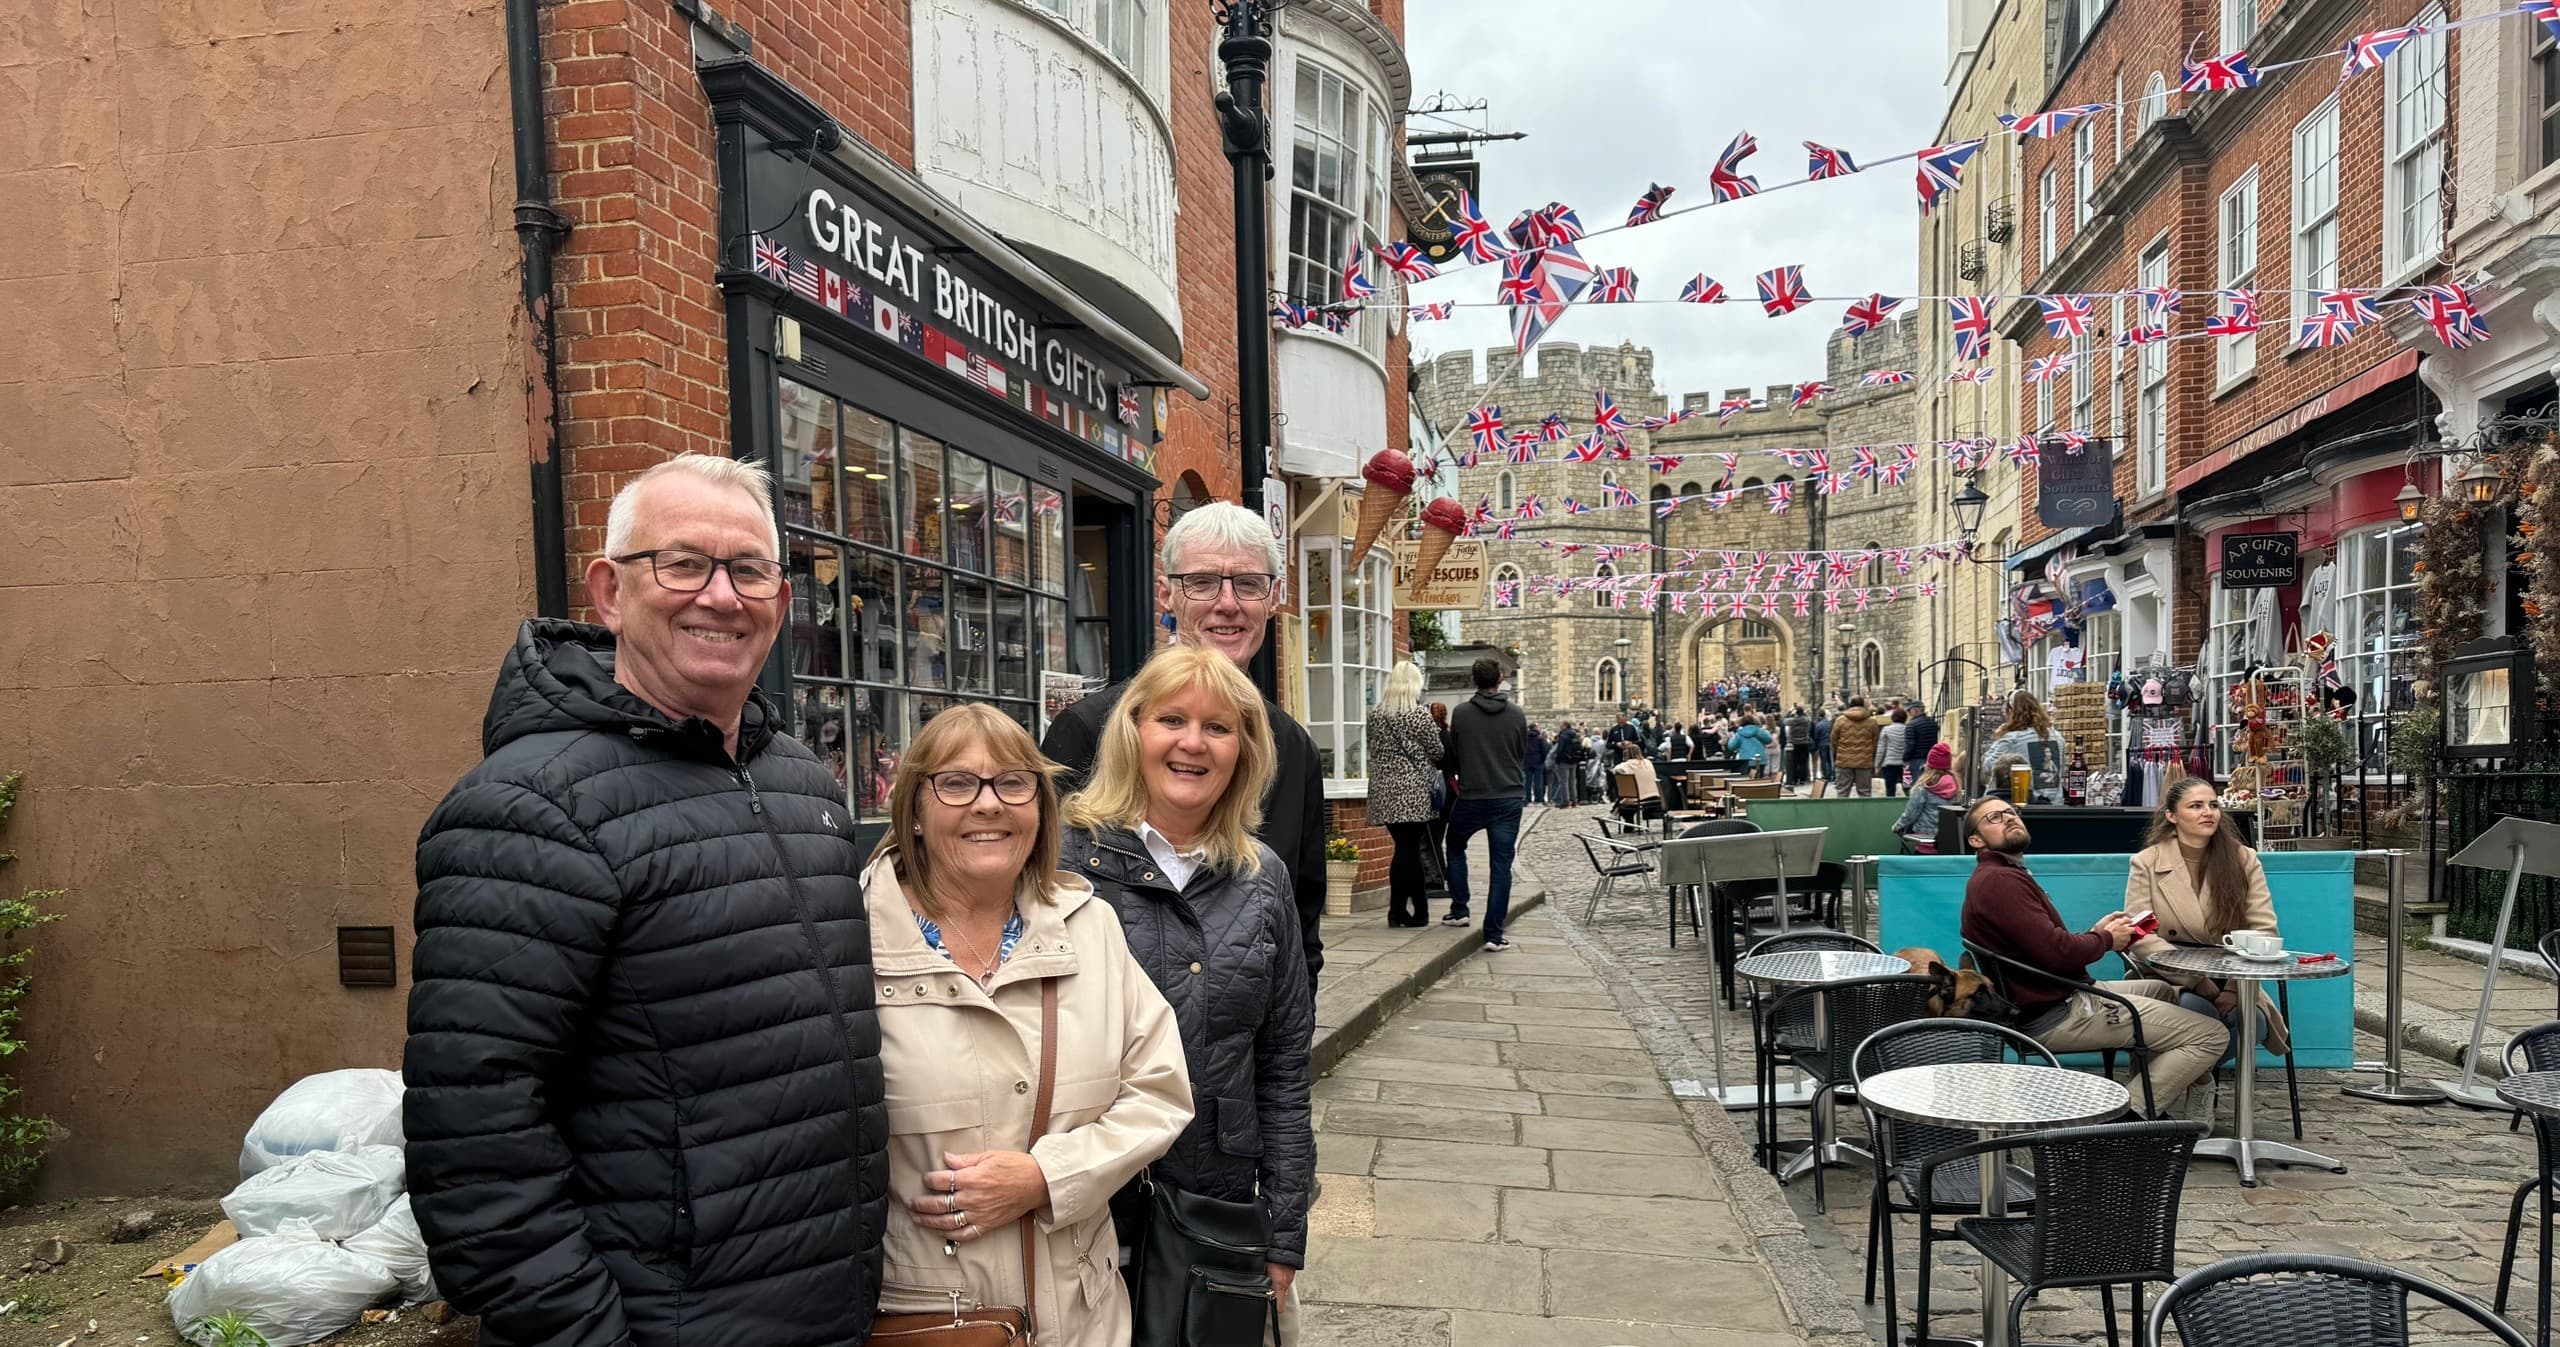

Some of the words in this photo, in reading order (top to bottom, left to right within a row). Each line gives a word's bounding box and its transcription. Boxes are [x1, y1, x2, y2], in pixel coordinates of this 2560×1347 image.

[808, 188, 924, 303] GREAT
[935, 263, 1037, 372] BRITISH
[1046, 338, 1107, 412] GIFTS
[2252, 539, 2292, 556] GIFTS
[2256, 555, 2265, 565] &
[2226, 567, 2293, 579] SOUVENIRS
